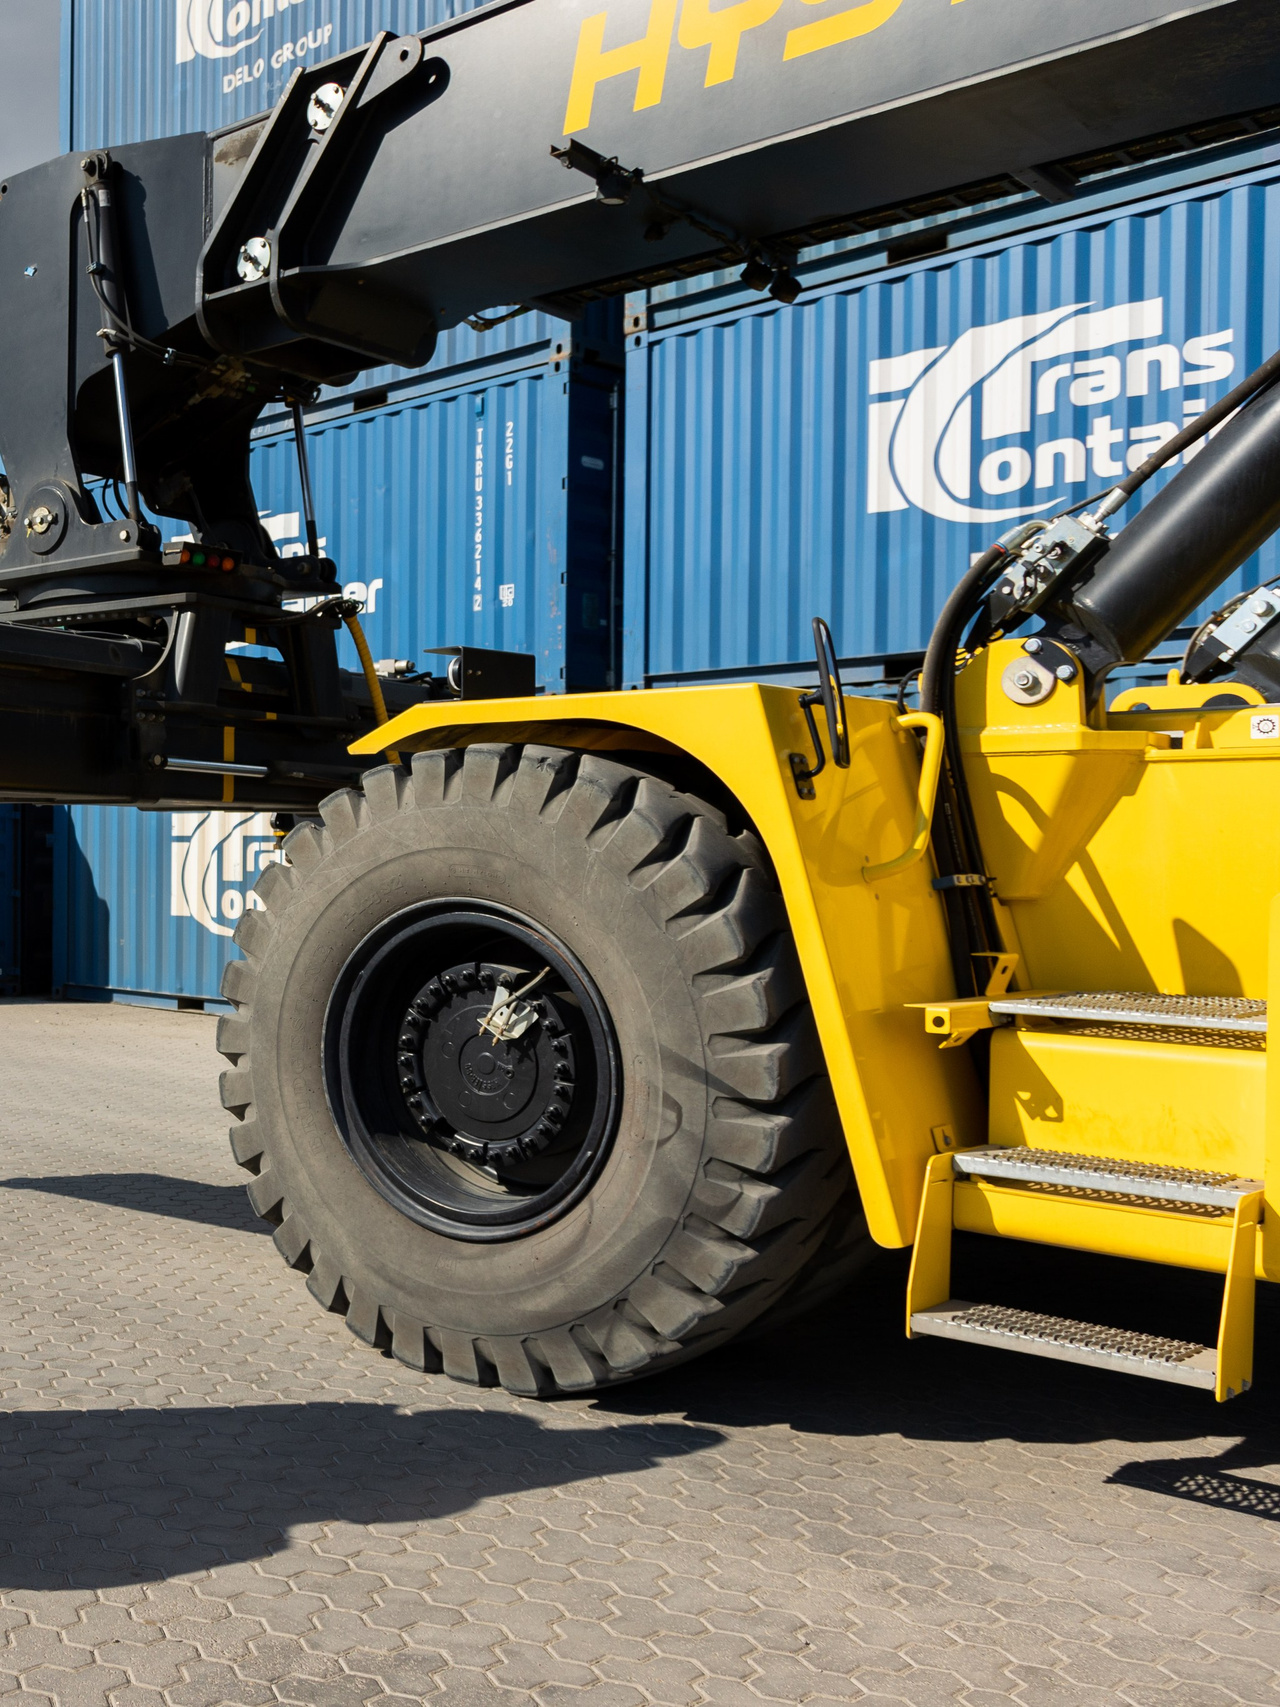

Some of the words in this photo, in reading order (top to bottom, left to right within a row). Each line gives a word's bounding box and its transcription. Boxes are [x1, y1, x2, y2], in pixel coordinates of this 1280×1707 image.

[223, 58, 265, 94] DELO
[271, 23, 333, 69] GROUP
[868, 297, 1235, 440] Trans
[475, 427, 483, 492] TKRU
[505, 421, 514, 486] 22G1
[474, 495, 482, 591] 336214
